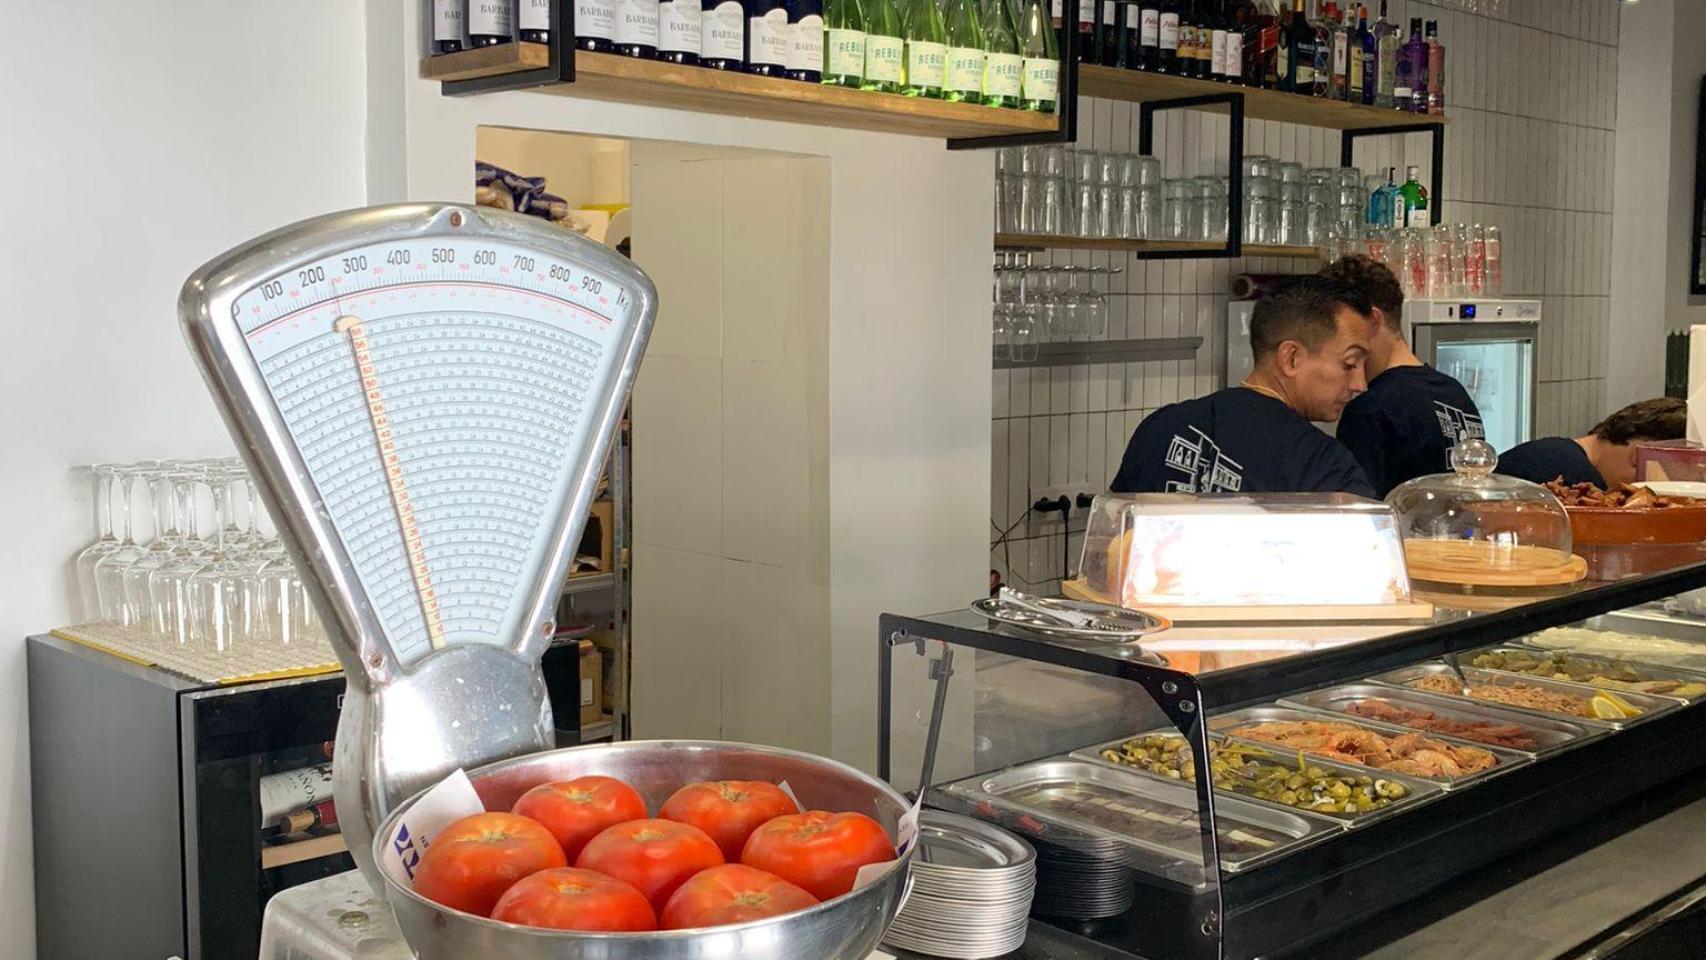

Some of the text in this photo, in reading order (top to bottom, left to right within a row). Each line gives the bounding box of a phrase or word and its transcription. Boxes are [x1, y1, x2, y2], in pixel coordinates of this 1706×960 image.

[259, 281, 284, 302] 100
[299, 266, 325, 288] 200
[342, 255, 368, 274] 300
[387, 249, 411, 265] 400
[432, 248, 455, 263] 500
[474, 250, 496, 265] 600
[513, 255, 535, 272] 700
[549, 264, 571, 282] 800
[581, 276, 602, 295] 900
